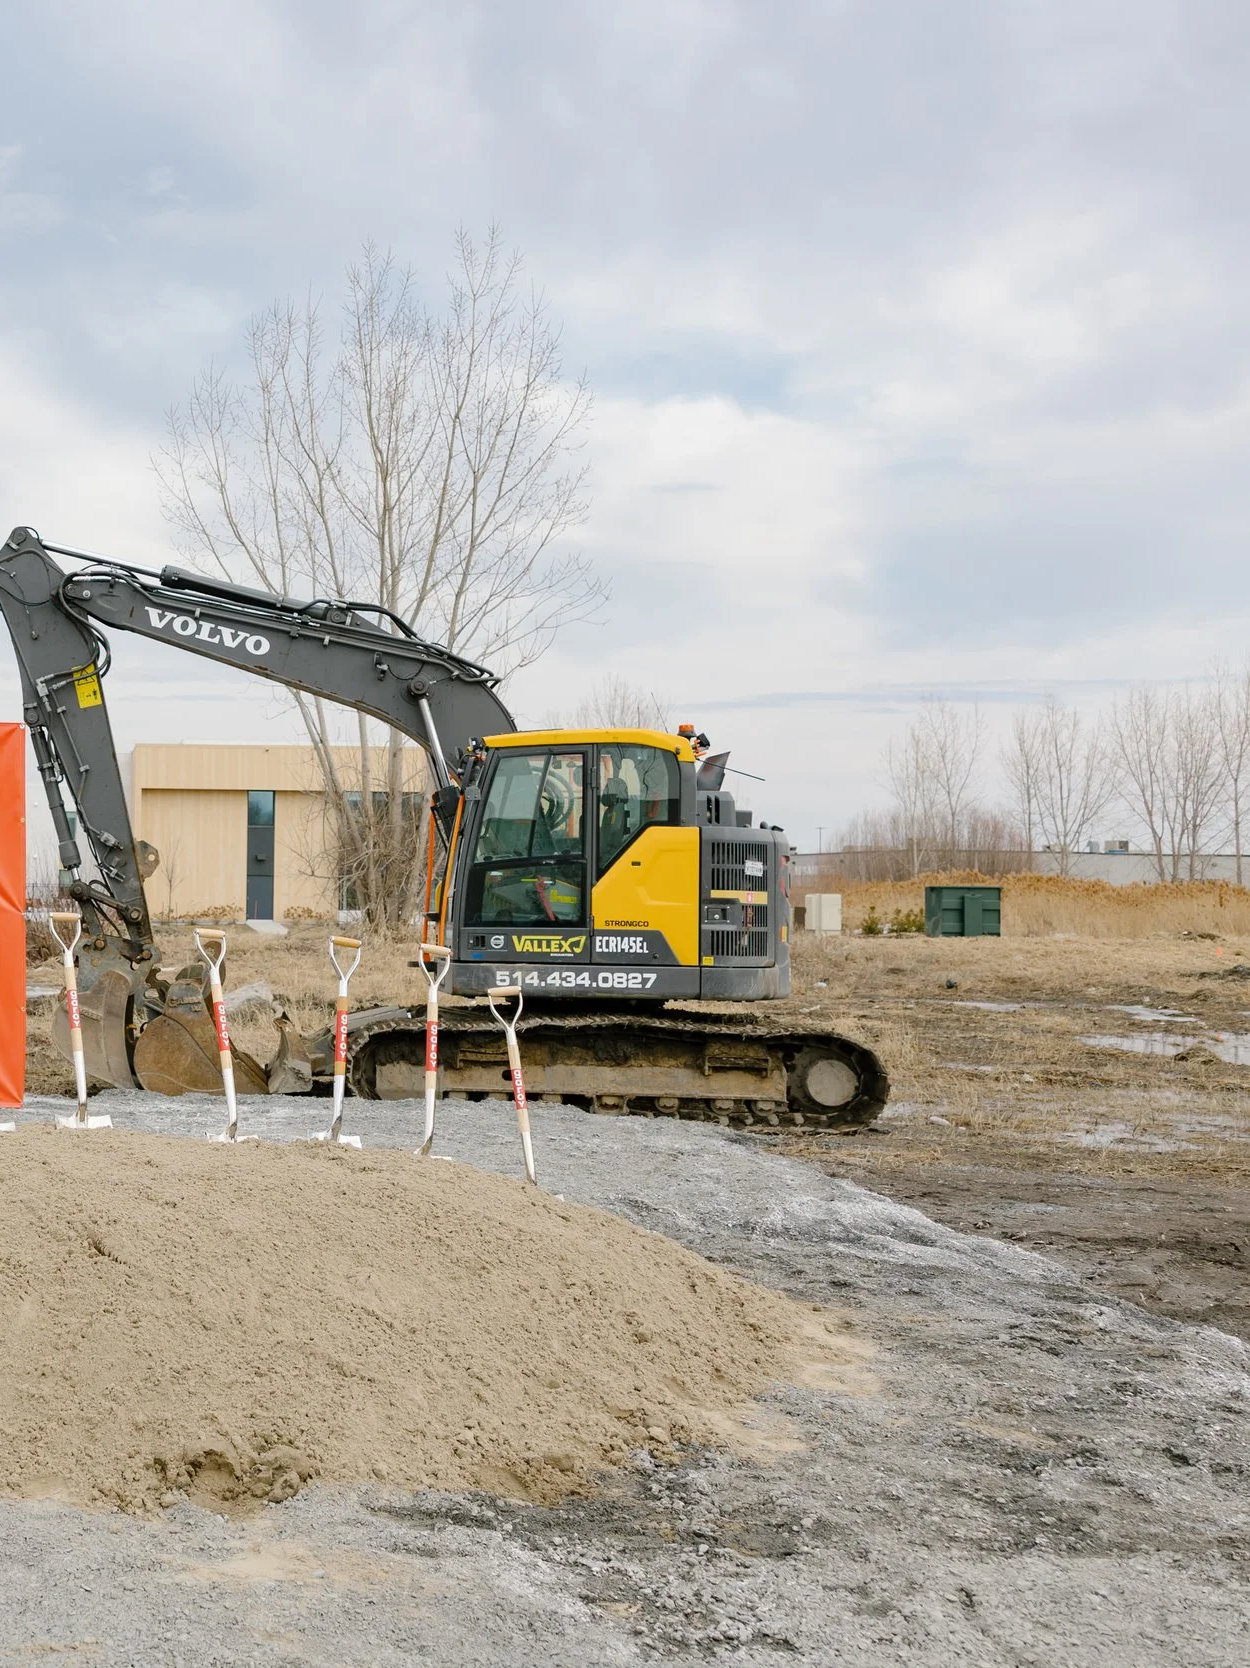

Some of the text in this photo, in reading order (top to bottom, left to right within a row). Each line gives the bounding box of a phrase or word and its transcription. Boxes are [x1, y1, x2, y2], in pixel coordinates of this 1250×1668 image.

[144, 606, 270, 656] VOLVO
[604, 920, 649, 928] STRONGCO
[512, 935, 573, 953] VALLEX
[495, 971, 657, 989] 514.434.0827
